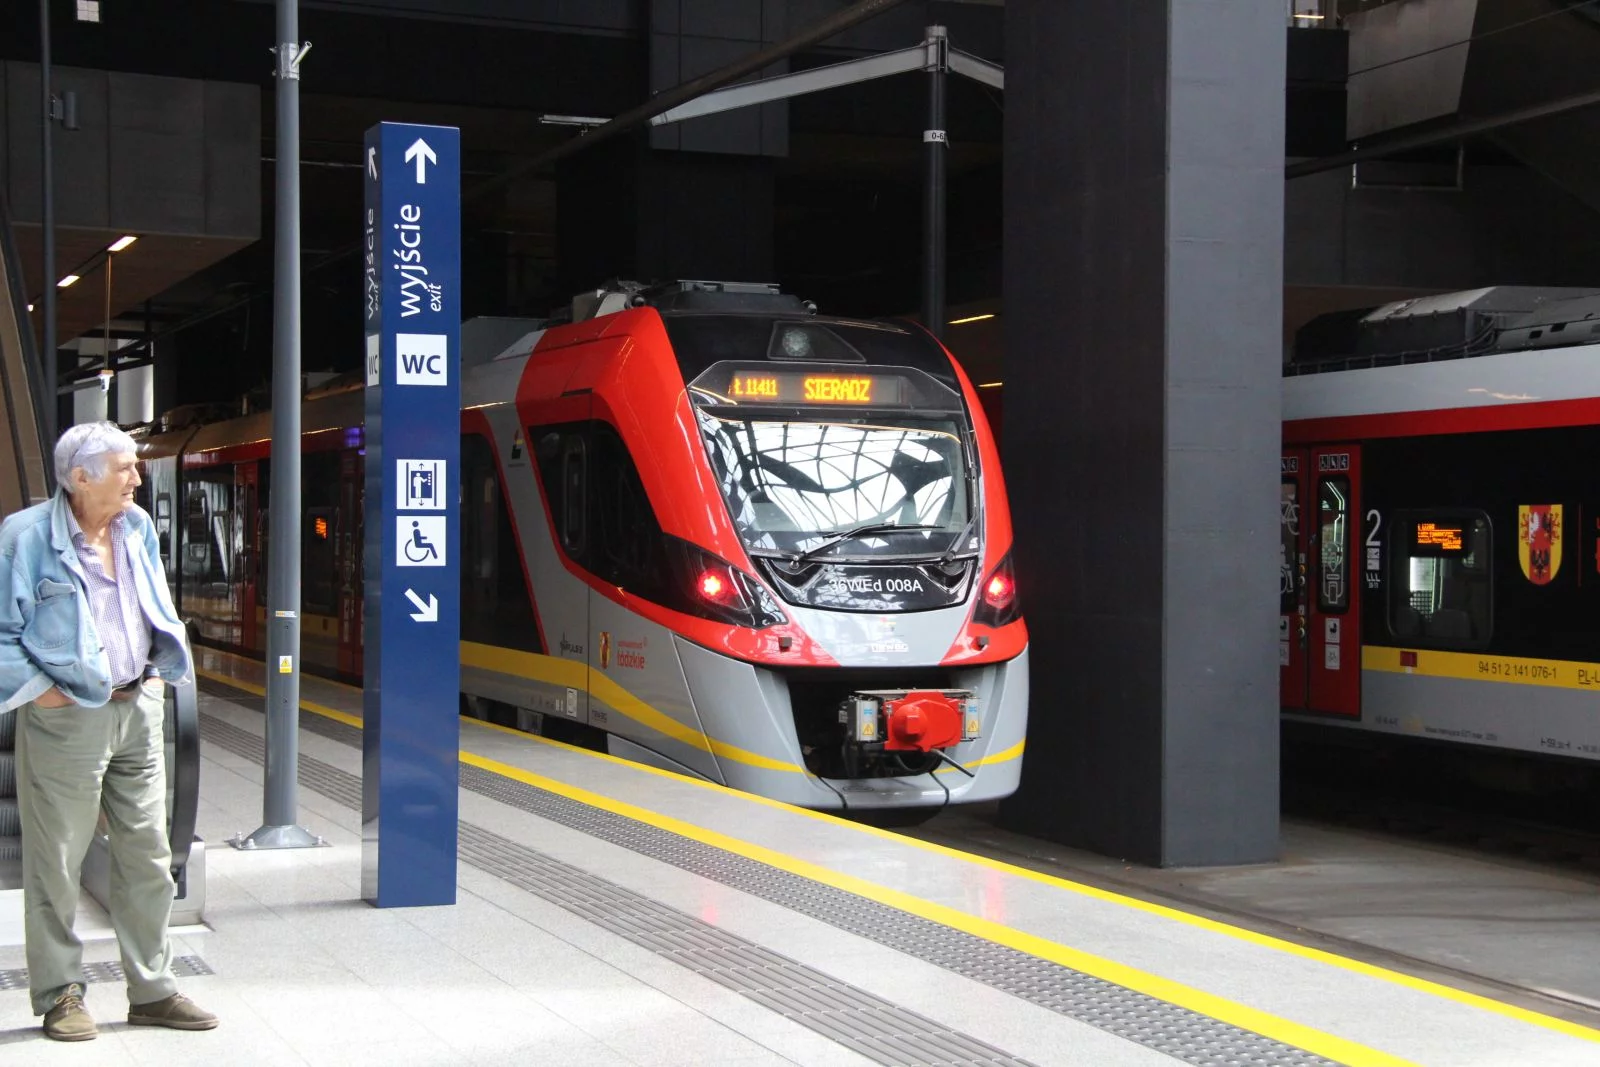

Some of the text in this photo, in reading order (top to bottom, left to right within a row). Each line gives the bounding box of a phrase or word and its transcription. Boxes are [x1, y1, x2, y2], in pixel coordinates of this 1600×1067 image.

[366, 208, 378, 321] wyjście
[393, 204, 428, 318] wyjście
[427, 283, 442, 312] exit
[368, 354, 378, 376] WC
[402, 354, 441, 375] WC
[804, 378, 871, 402] SIERADZ
[1365, 508, 1382, 547] 2
[828, 578, 925, 593] 36WEd 008A
[1478, 660, 1489, 674] 94
[1491, 662, 1502, 675] 51
[1504, 663, 1511, 676] 2
[1513, 664, 1529, 677] 141
[1531, 665, 1558, 679] 076-1
